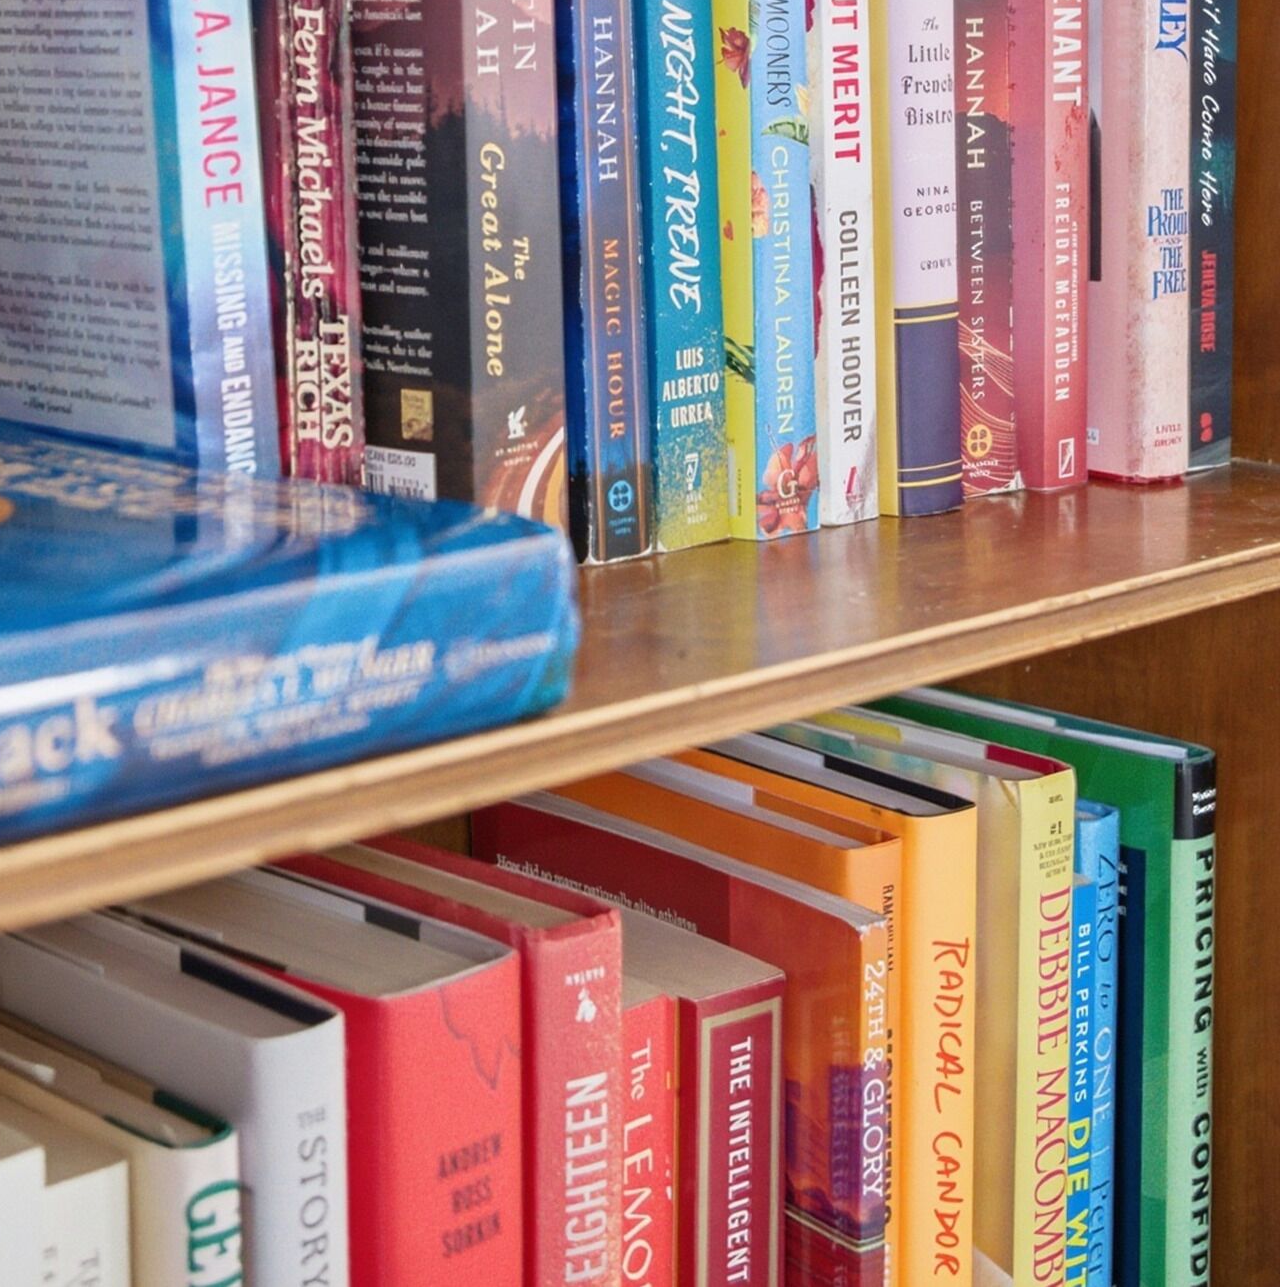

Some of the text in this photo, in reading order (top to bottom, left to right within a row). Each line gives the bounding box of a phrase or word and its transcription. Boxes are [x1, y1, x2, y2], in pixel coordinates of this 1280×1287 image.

[593, 16, 619, 184] HANNAH
[832, 43, 862, 164] MERIT
[901, 73, 953, 95] French
[908, 42, 951, 64] Little
[965, 16, 986, 170] HANNAH
[1200, 27, 1221, 87] Have
[196, 64, 244, 208] JANCE
[293, 4, 335, 301] Fern Michaels
[1201, 93, 1220, 162] Come
[663, 166, 701, 315] IRENE
[916, 185, 950, 197] NINA
[1161, 188, 1185, 212] THE
[1199, 169, 1220, 227] Here
[213, 221, 248, 331] MISSING
[479, 142, 511, 379] Great Alone
[511, 236, 530, 282] The
[770, 145, 798, 435] CHRISTINA LAUREN
[969, 199, 986, 401] BETWEEN SISTERS
[1054, 181, 1070, 402] FREIDA McFADDEN
[1152, 268, 1187, 301] FREE
[1159, 245, 1184, 270] THE
[222, 333, 246, 374] AND
[320, 314, 355, 450] TEXAS
[603, 238, 626, 440] MAGIC HOUR
[675, 346, 705, 372] LUIS
[838, 210, 863, 445] COLLEEN HOOVER
[296, 338, 320, 442] RICH
[662, 372, 720, 403] ALBERTO
[670, 401, 714, 429] URREA
[496, 853, 522, 875] How
[522, 860, 540, 879] did
[541, 868, 553, 882] so
[1096, 853, 1117, 964] ZERO
[1036, 885, 1073, 1057] DEBBIE
[1076, 922, 1092, 983] BILL
[1194, 846, 1214, 1035] PRICING
[862, 959, 887, 1198] 24TH & GLORY
[1074, 988, 1090, 1104] PERKINS
[1093, 1026, 1113, 1127] ONE
[436, 1131, 504, 1181] ANDREW
[622, 1036, 654, 1287] The LEMO
[725, 1035, 753, 1284] THE INTELLIGENT
[931, 936, 972, 1277] RADICAL CANDOR
[1067, 1116, 1092, 1197] DIE
[450, 1178, 495, 1215] ROSS
[565, 1071, 610, 1284] EIGHTEEN
[1190, 1111, 1211, 1287] CONFID
[440, 1215, 504, 1260] SORKIN
